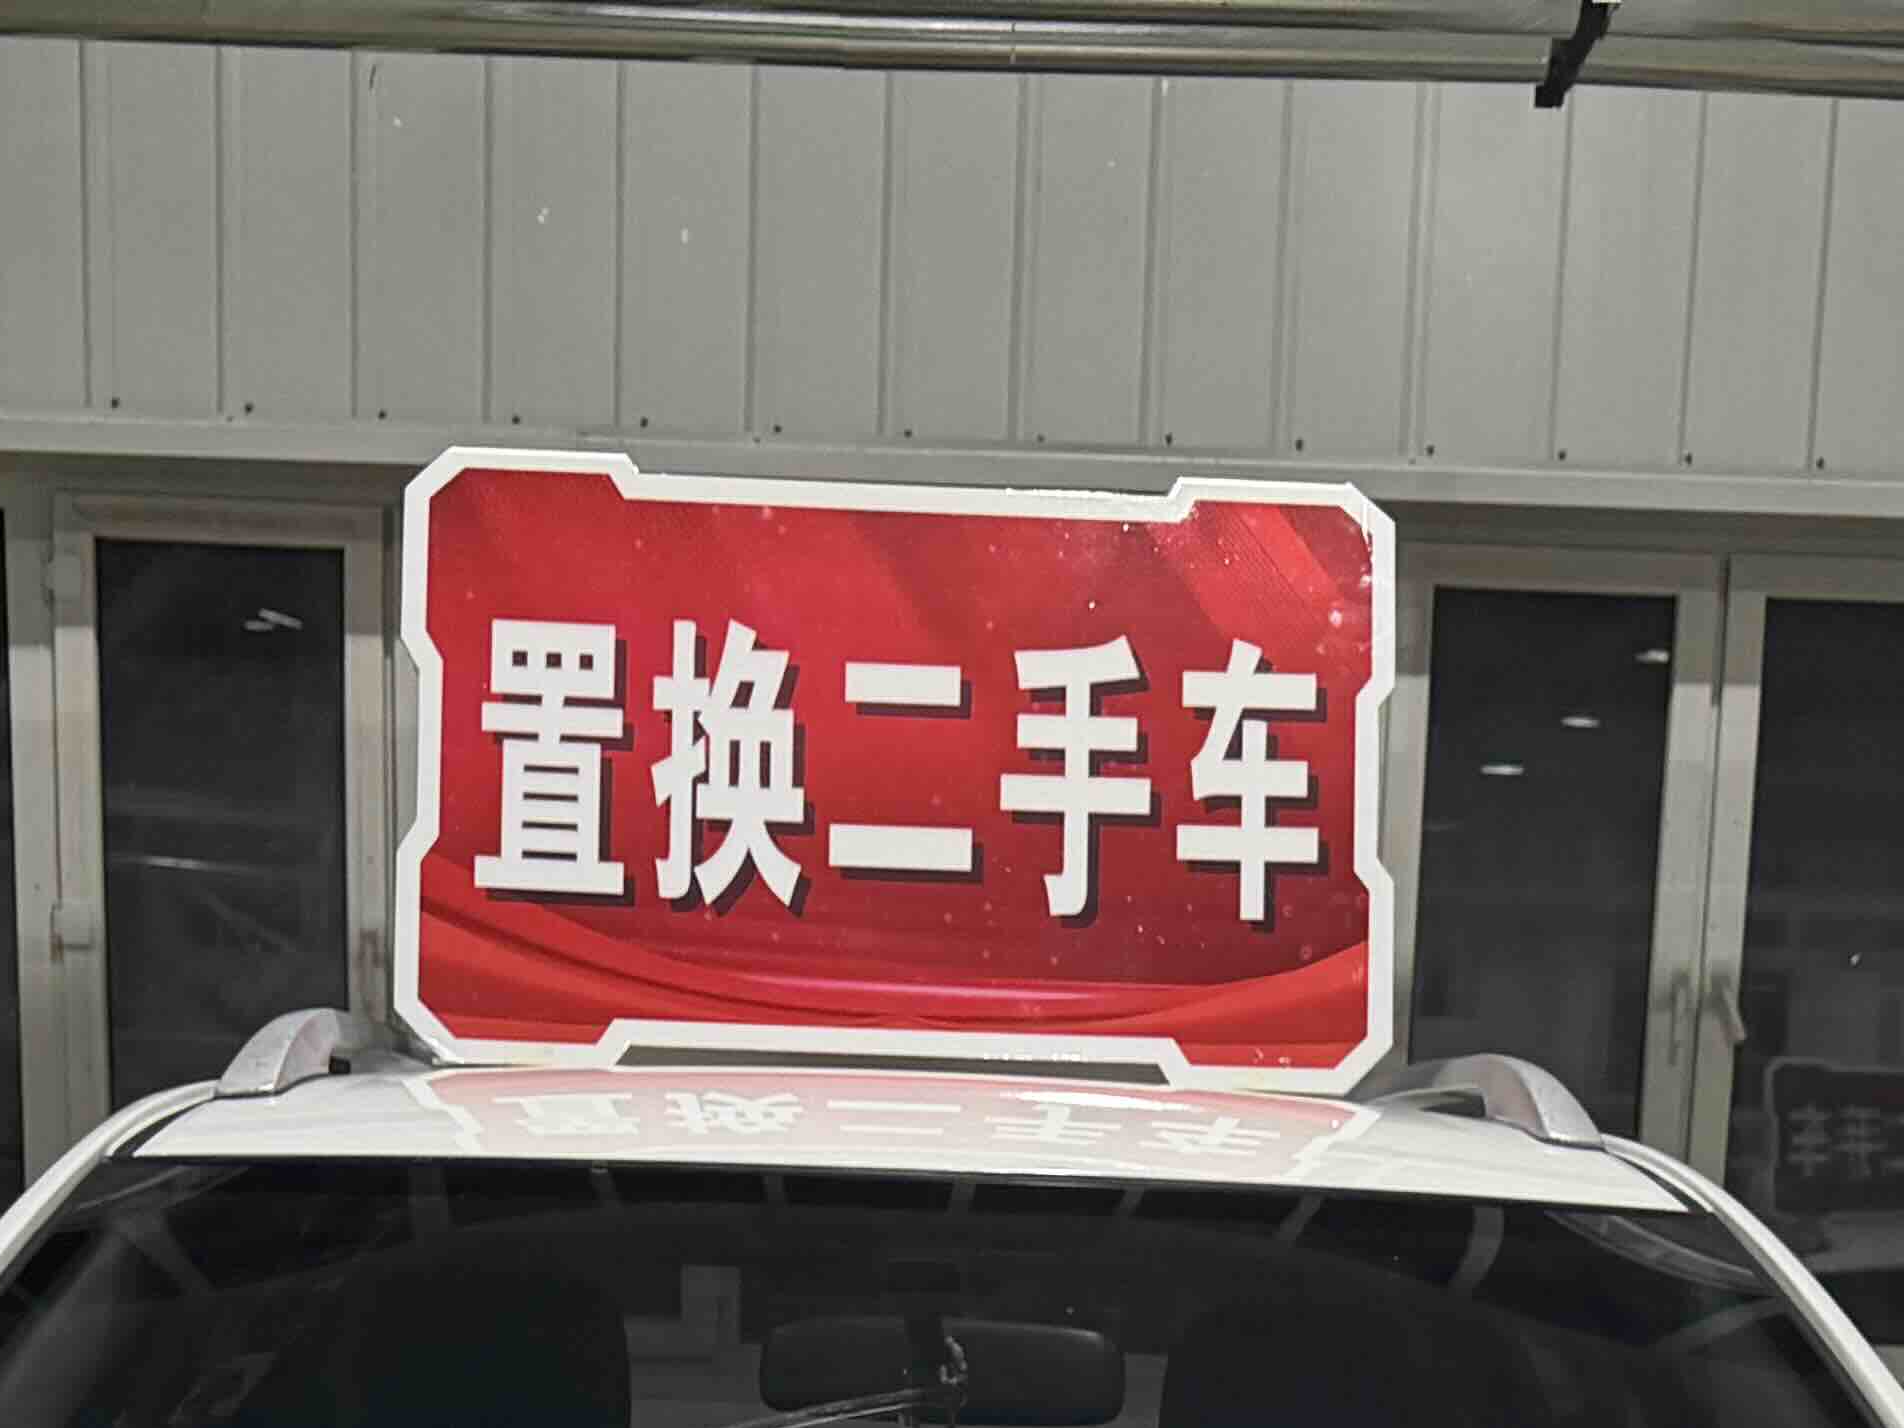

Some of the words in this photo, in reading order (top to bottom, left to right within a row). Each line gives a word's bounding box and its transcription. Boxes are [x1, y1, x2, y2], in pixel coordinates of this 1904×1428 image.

[474, 618, 1318, 921] 置换二手车
